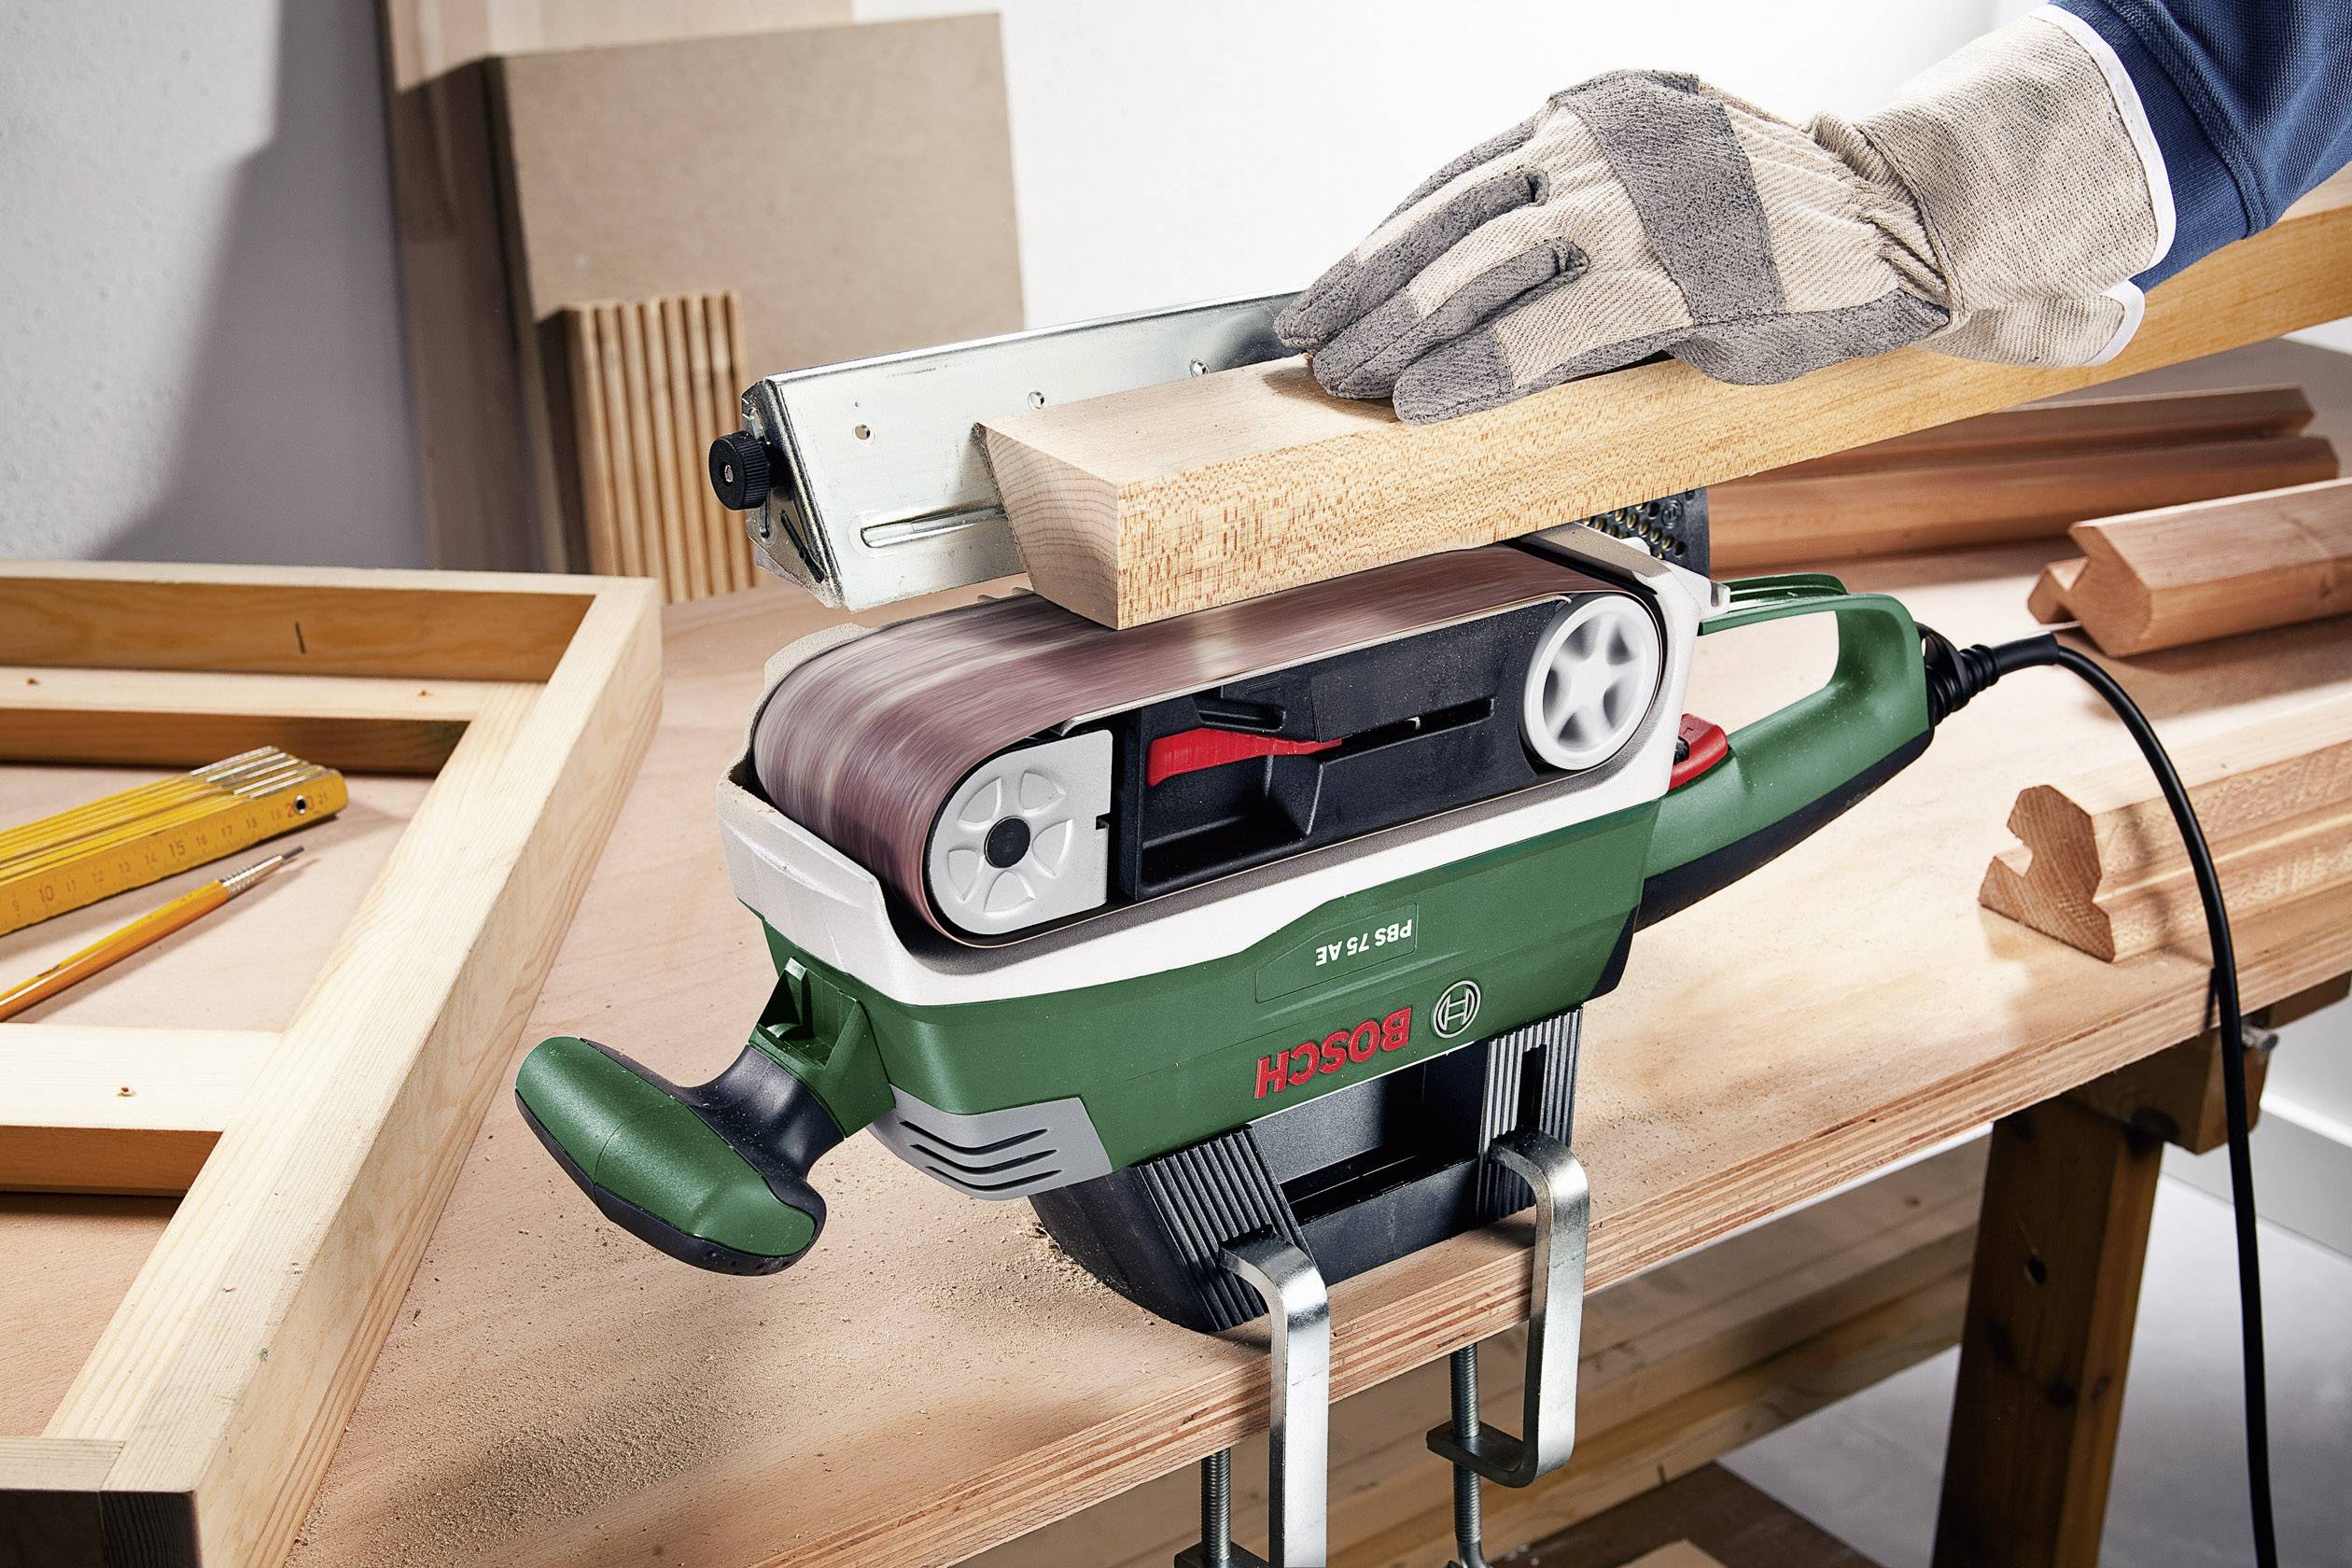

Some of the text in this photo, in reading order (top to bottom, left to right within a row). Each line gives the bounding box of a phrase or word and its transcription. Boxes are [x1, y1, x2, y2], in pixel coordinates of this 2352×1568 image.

[38, 885, 56, 903] 10
[65, 879, 77, 892] 11
[92, 870, 105, 883] 12
[118, 861, 131, 873] 13
[168, 839, 187, 859] 15
[220, 825, 233, 837] 17
[1315, 918, 1412, 967] PBS 75 AE
[1254, 1007, 1412, 1099] BOSCH
